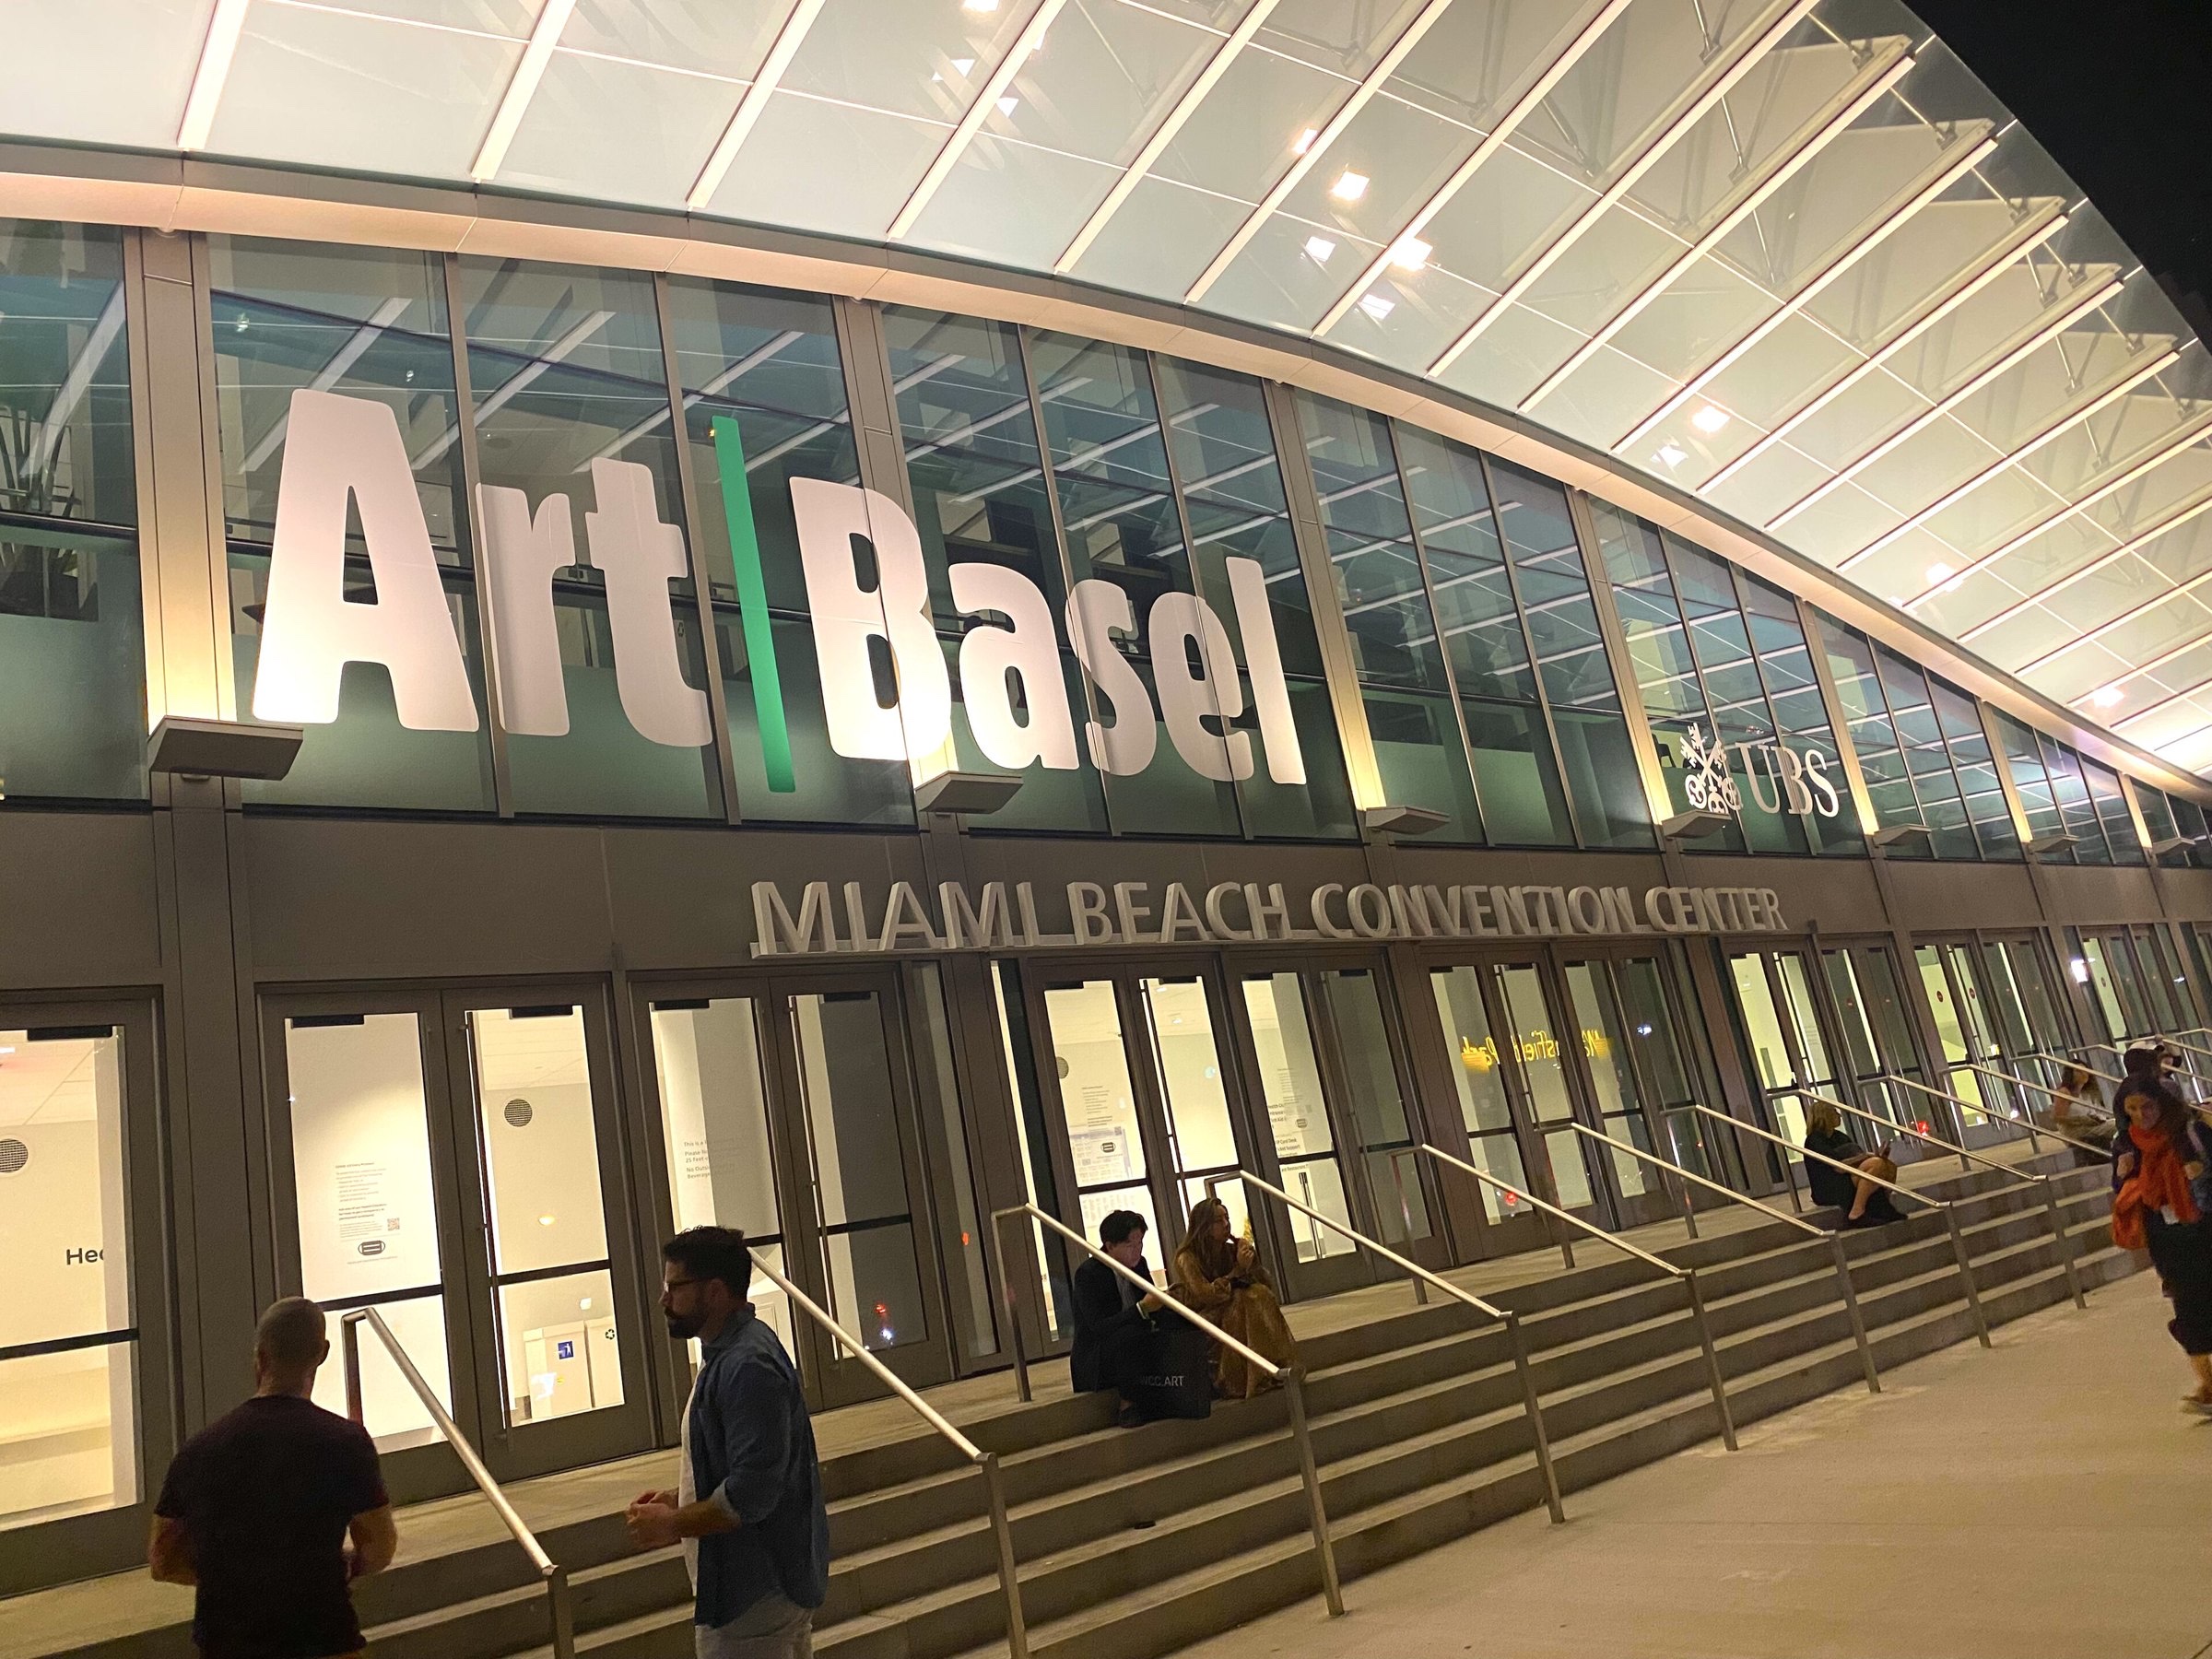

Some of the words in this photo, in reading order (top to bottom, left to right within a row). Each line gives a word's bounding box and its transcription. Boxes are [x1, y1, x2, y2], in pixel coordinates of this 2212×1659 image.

[253, 389, 713, 747] Art
[789, 476, 1307, 785] Basel
[1735, 741, 1840, 818] UBS
[750, 880, 1041, 954] MIAMI
[1065, 881, 1292, 946] BEACH
[1310, 882, 1639, 938] CONVENTION
[1644, 886, 1790, 933] CENTER
